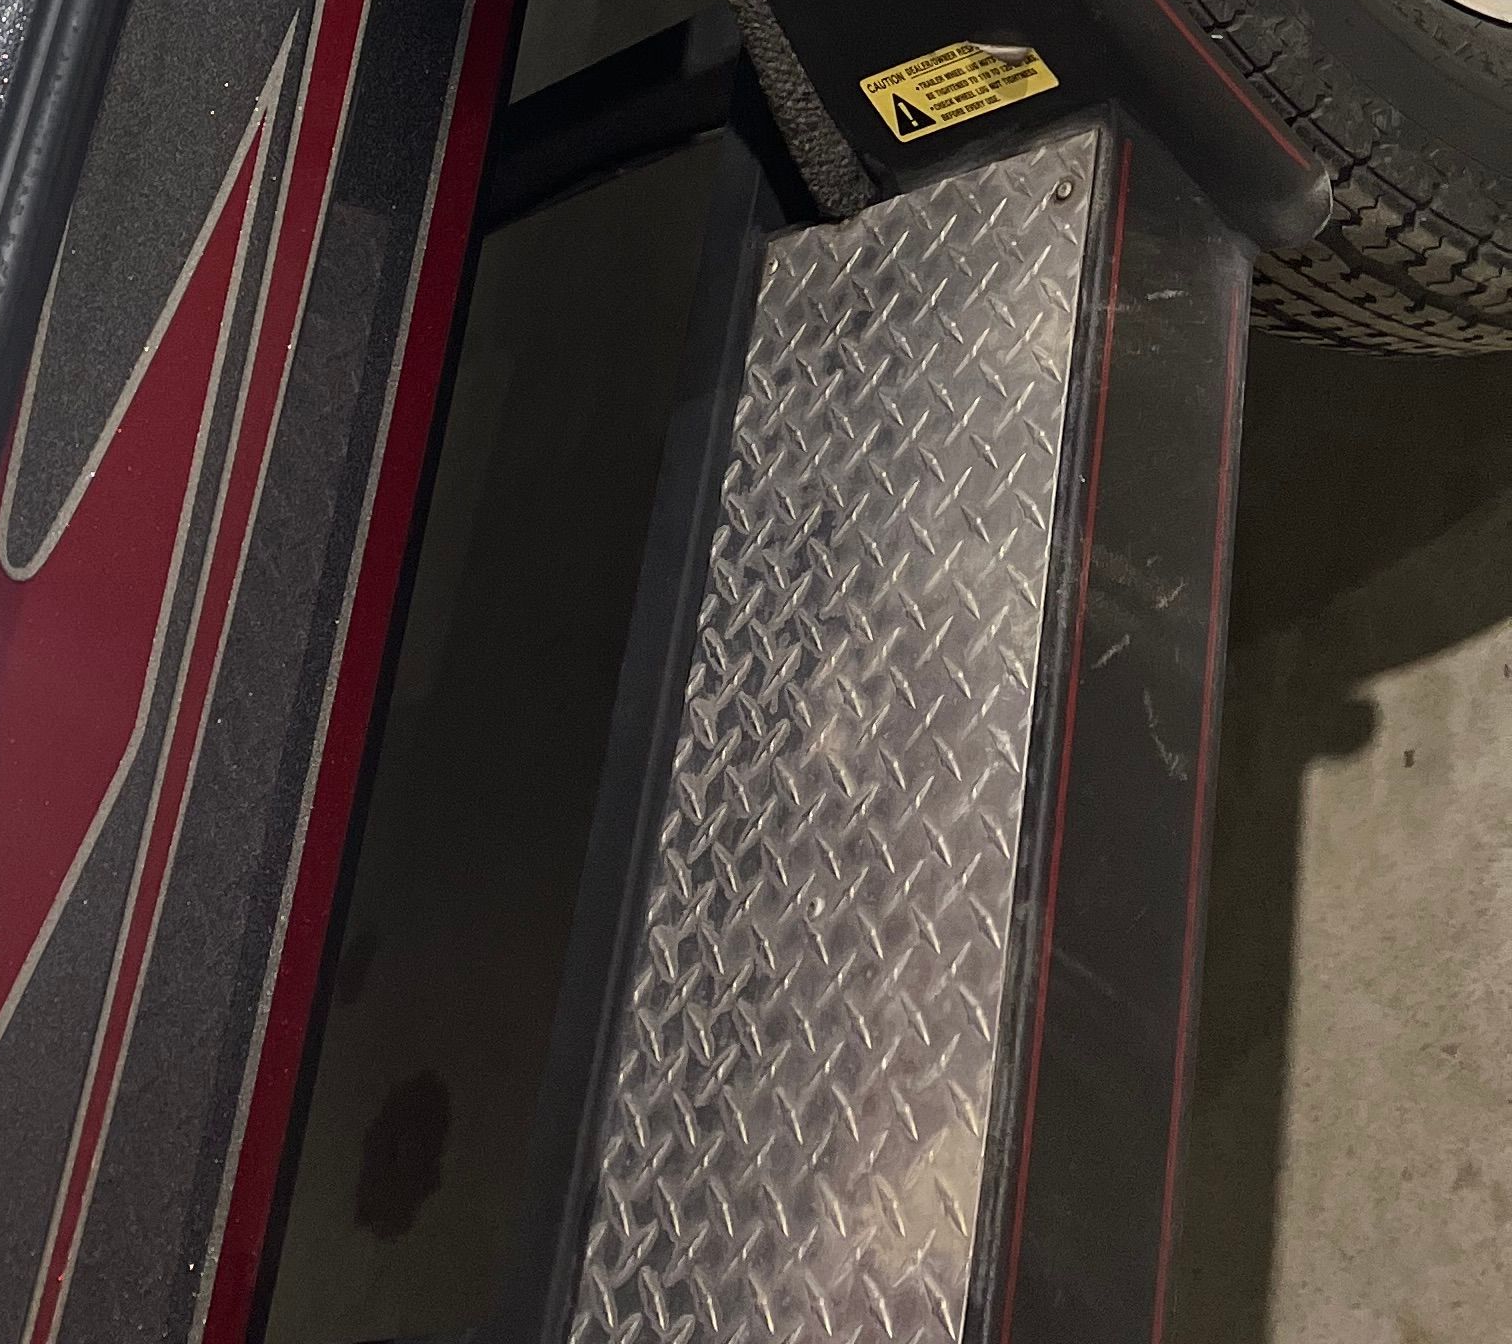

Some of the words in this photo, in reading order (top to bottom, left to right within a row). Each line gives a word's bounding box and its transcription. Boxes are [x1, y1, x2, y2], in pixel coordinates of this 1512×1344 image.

[866, 72, 907, 94] CAUTION
[918, 75, 946, 89] TRAILER
[943, 67, 966, 80] WHEEL
